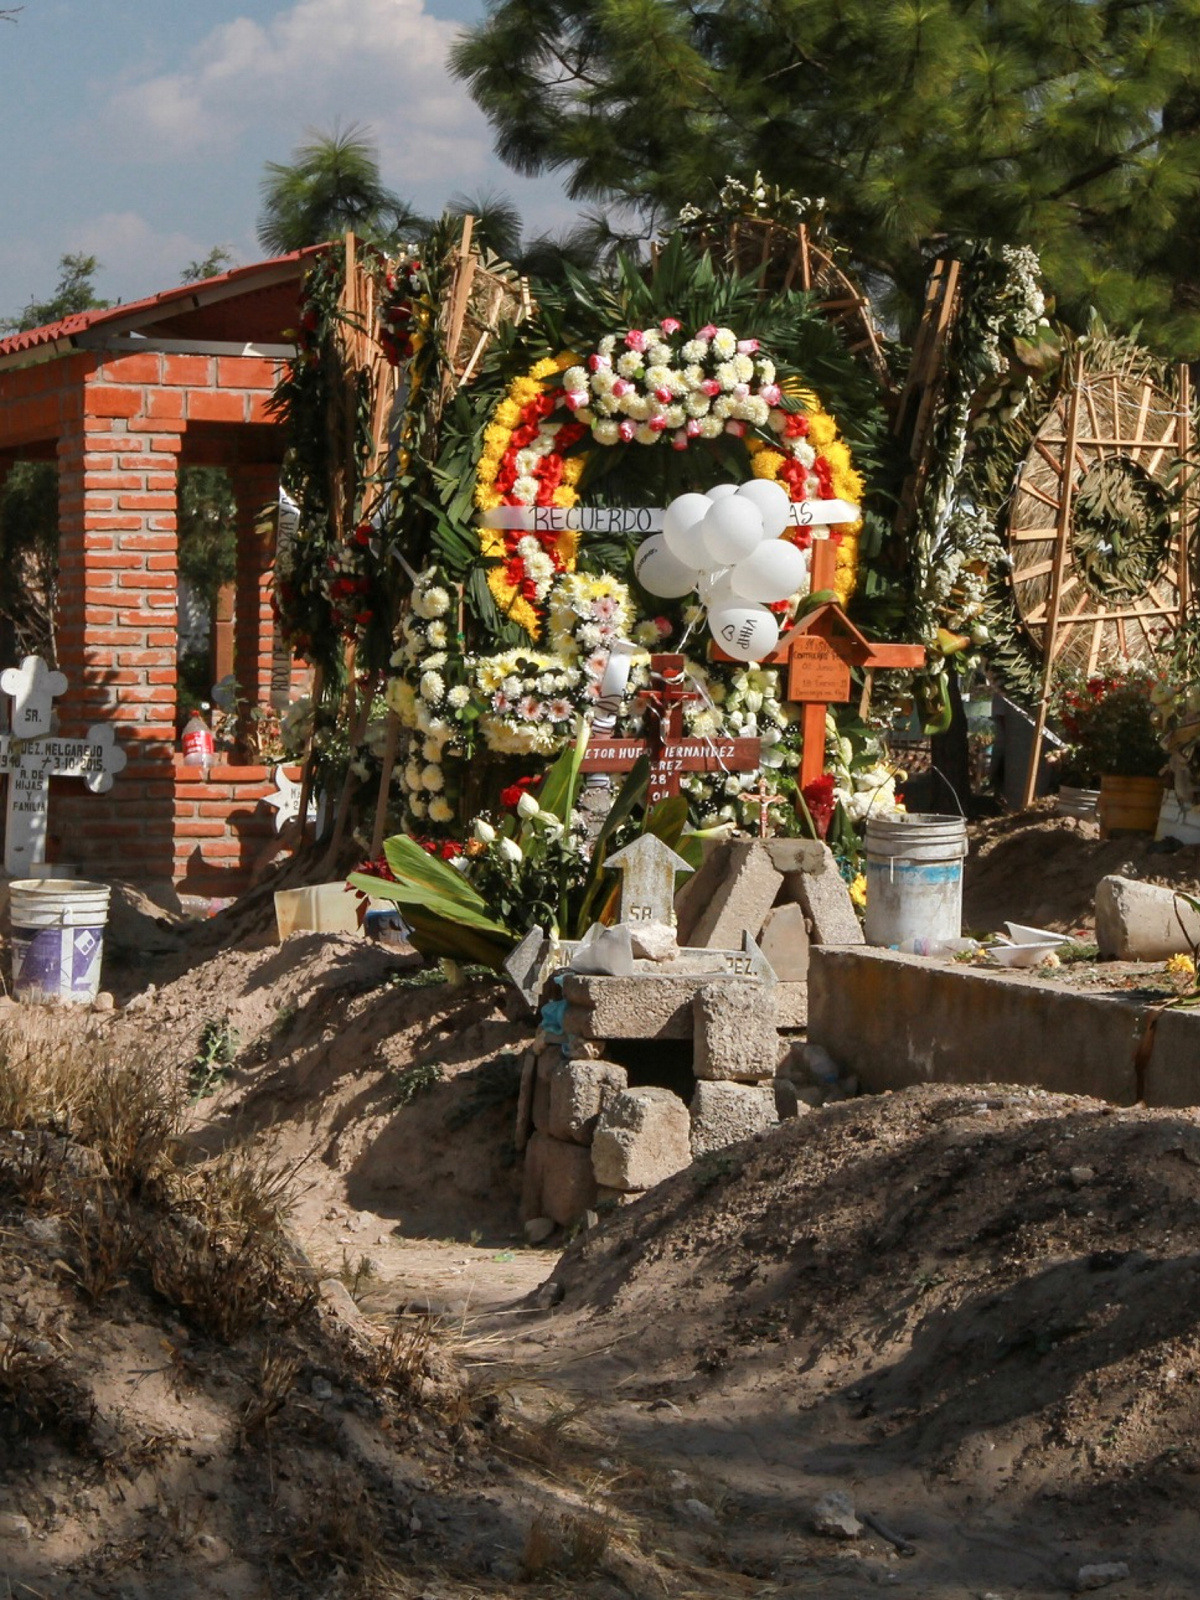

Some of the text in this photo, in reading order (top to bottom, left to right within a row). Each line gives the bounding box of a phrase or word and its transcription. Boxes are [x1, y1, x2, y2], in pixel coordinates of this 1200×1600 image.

[529, 506, 652, 532] RECUERDO
[24, 708, 42, 722] SR.
[45, 743, 103, 757] MELGAREJO
[15, 780, 43, 791] HIJAS
[650, 773, 667, 785] 28
